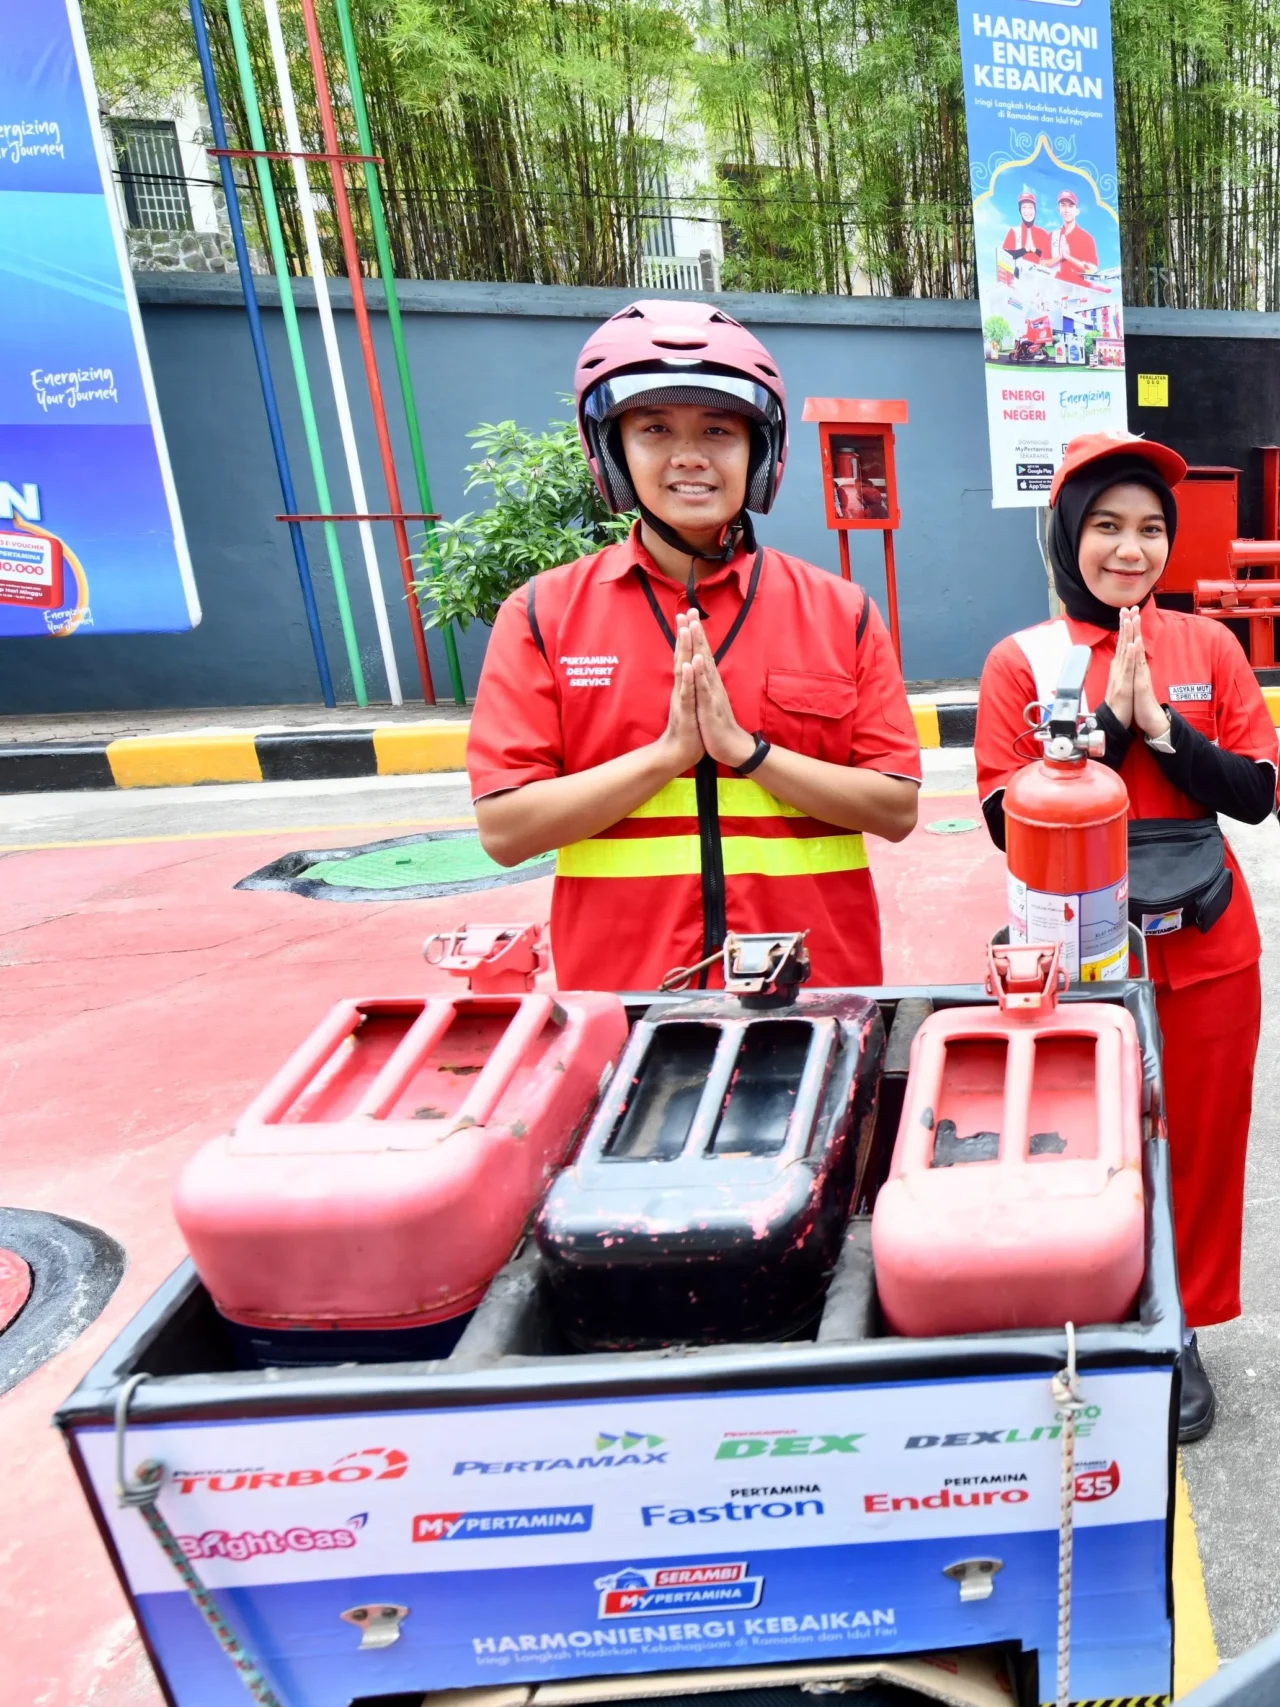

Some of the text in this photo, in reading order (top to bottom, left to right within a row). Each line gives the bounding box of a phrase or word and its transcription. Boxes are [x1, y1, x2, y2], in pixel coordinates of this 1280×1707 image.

[973, 13, 1098, 49] HARMONI
[992, 41, 1083, 73] ENERGI
[973, 63, 1103, 100] KEBAIKAN
[974, 97, 1103, 119] Iringi Langkah Hadirkan Kebahagiaan
[1007, 111, 1039, 122] Ramadan
[1041, 115, 1054, 123] dan
[1056, 117, 1068, 125] Idul
[1070, 118, 1083, 126] Fitri
[9, 141, 64, 163] Journey
[30, 367, 113, 391] Energizing
[36, 387, 118, 412] Your Journey
[1001, 389, 1045, 401] ENERGI
[1060, 390, 1111, 409] Energizing
[1003, 410, 1046, 421] NEGERI
[5, 541, 45, 551] E-VOUCHER
[19, 589, 43, 597] Minggu
[43, 607, 91, 622] Energizing
[560, 656, 619, 665] PERTAMINA
[566, 667, 614, 676] DELIVERY
[569, 678, 611, 687] SERVICE
[1144, 924, 1179, 936] PERTAMINA
[714, 1432, 867, 1461] DEX
[452, 1451, 668, 1477] PERTAMAX
[731, 1483, 821, 1498] PERTAMINA
[944, 1472, 1028, 1487] PERTAMINA
[863, 1488, 1029, 1515] Enduro
[641, 1498, 824, 1528] Fastron
[418, 1511, 586, 1539] MyPERTAMINA
[284, 1527, 357, 1553] Gas
[657, 1567, 739, 1586] SERAMBI
[620, 1588, 743, 1611] MyPERTAMINA
[473, 1608, 896, 1655] HARMONIENERGI KEBAIKAN
[476, 1626, 897, 1667] Iringi Langkah Hadirkan Kebahagiaan di Ramadan dan Idul Fitri
